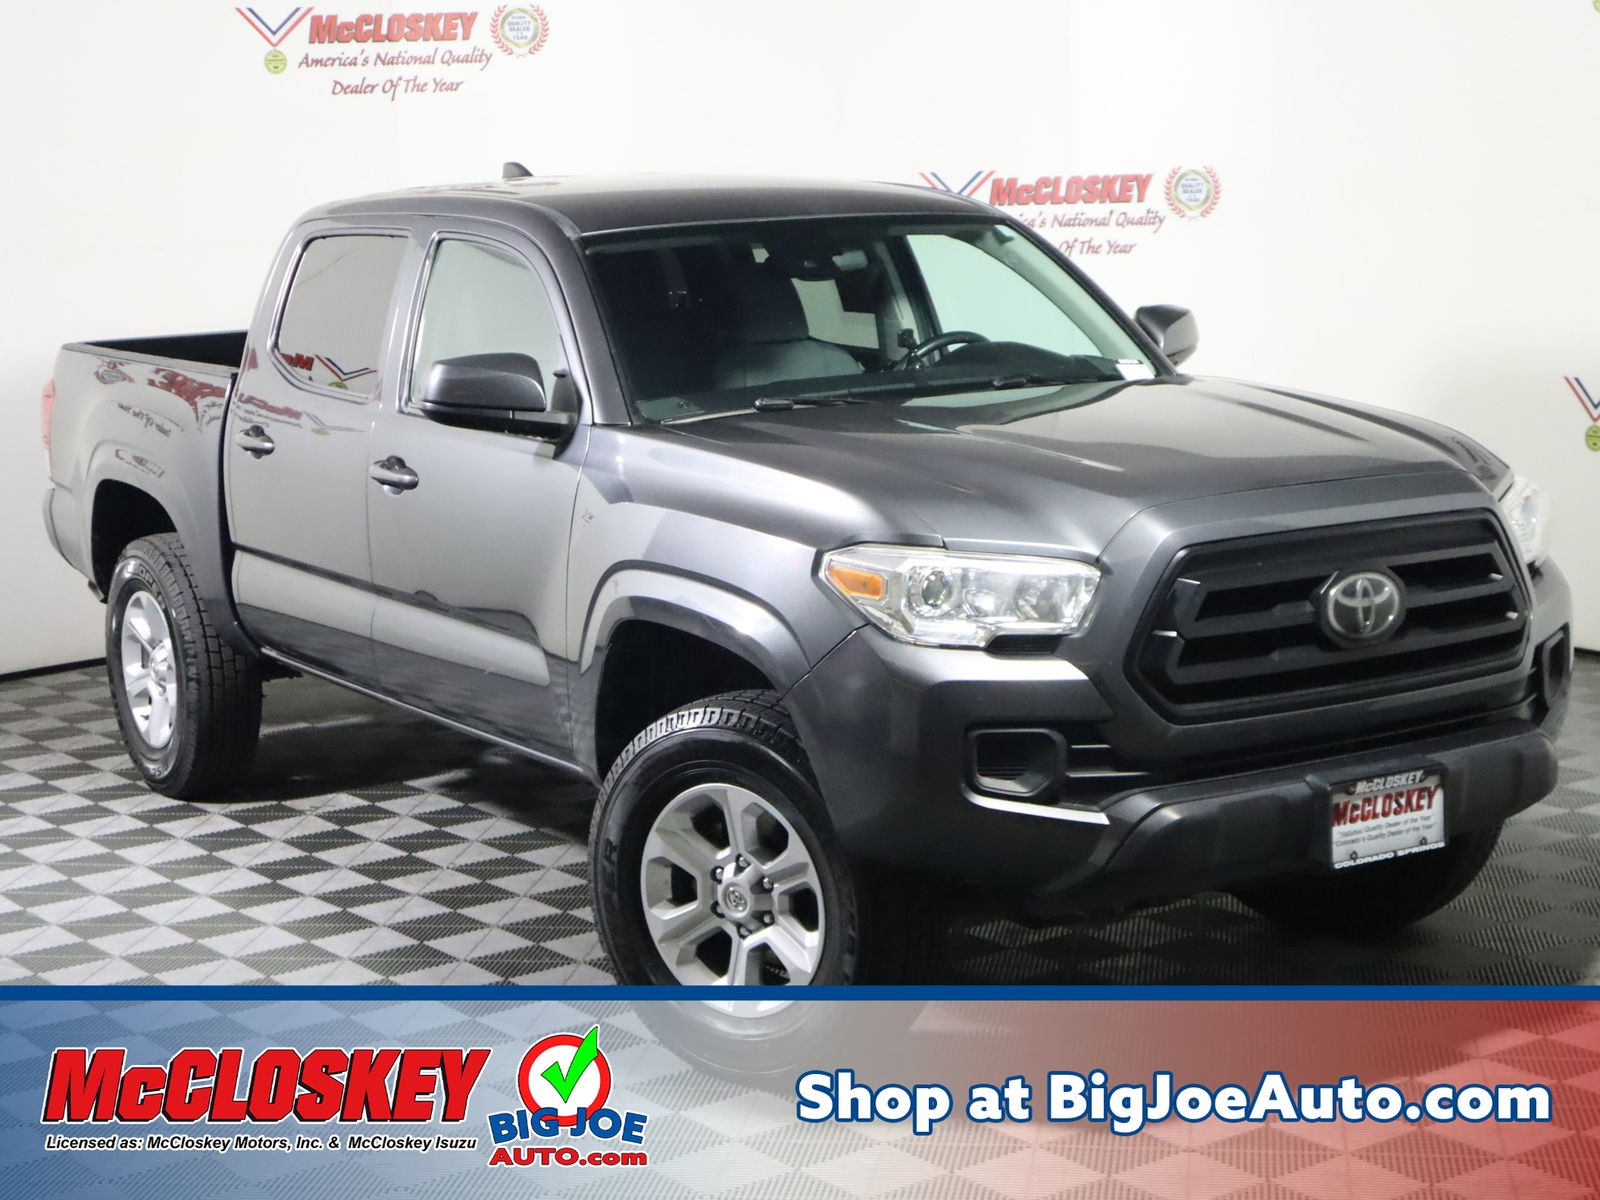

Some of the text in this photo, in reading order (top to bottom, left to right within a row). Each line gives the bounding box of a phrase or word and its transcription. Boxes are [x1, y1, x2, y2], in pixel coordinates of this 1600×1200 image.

[308, 11, 479, 44] McCLOSKEY
[298, 48, 369, 68] America's
[374, 47, 438, 67] National
[441, 45, 493, 72] Quality
[331, 75, 464, 101] Dealer Of The Year
[989, 173, 1154, 207] McCLOSKEY
[1050, 209, 1114, 228] National
[1116, 208, 1167, 234] Quality
[1080, 236, 1105, 256] The
[1107, 240, 1138, 255] Year
[1355, 769, 1424, 795] McCLOSKEY
[1331, 784, 1440, 827] McCLOSKEY
[1334, 851, 1395, 869] COLORADO
